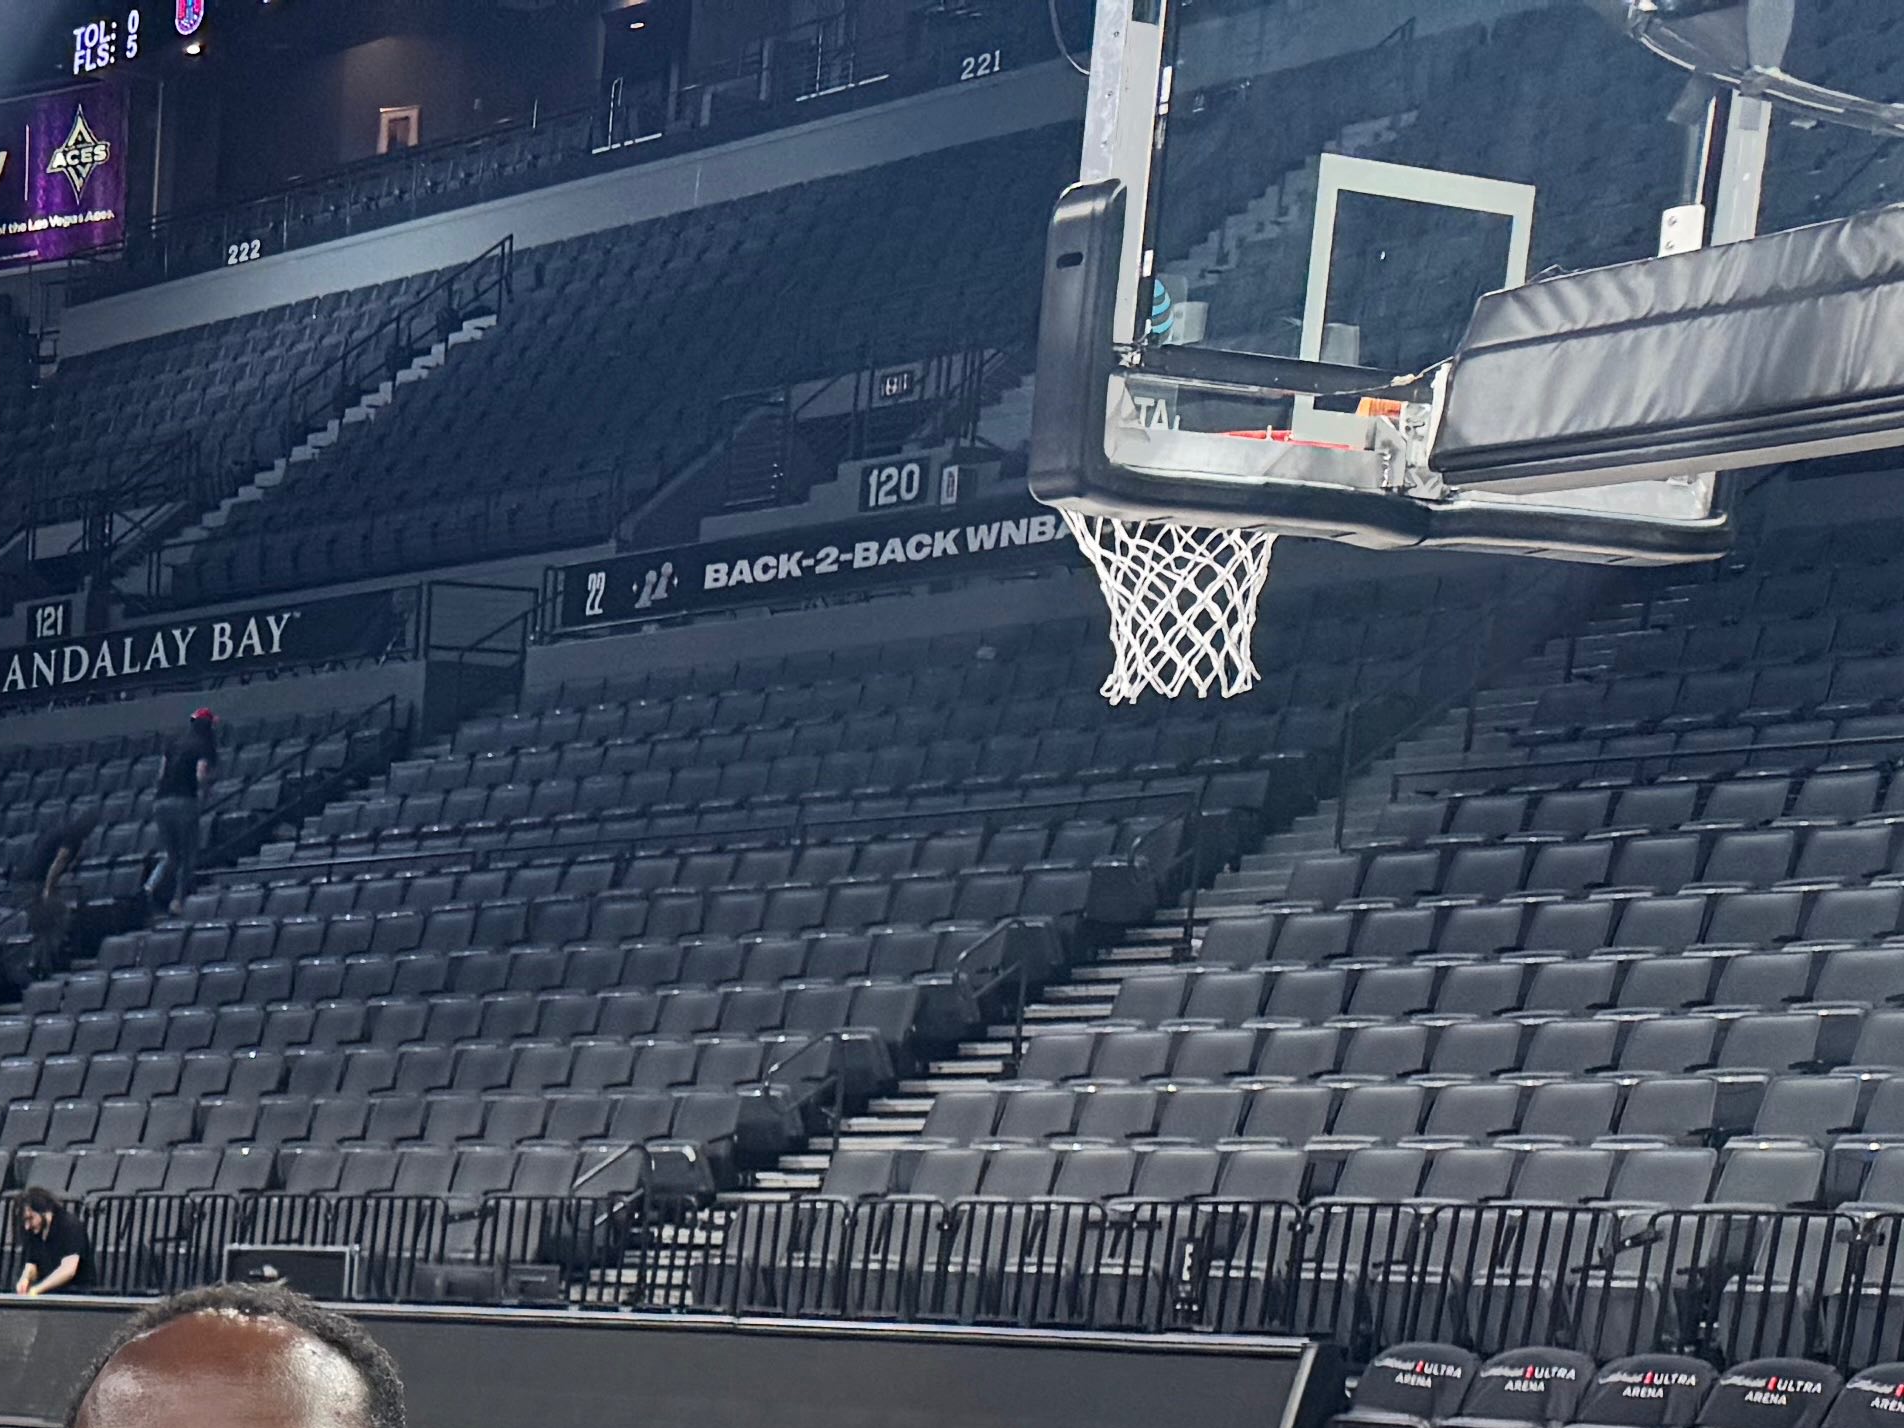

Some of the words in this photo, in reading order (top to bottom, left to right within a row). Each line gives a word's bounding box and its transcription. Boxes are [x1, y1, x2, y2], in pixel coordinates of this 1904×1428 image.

[73, 20, 117, 50] TOL:
[128, 9, 139, 34] 0
[73, 43, 116, 75] FLS:
[126, 34, 138, 59] 5
[960, 53, 1001, 82] 221
[50, 144, 108, 169] ACES
[8, 221, 27, 234] the
[28, 217, 49, 231] Las
[226, 239, 262, 266] 222
[868, 463, 920, 508] 120
[585, 572, 606, 615] 22
[704, 527, 961, 589] BACK-2-BACK
[966, 514, 1074, 552] WNB
[36, 604, 63, 638] 121
[210, 612, 291, 662] BAY
[1395, 1372, 1432, 1388] ARENA
[1424, 1364, 1462, 1379] ULTRA
[1534, 1365, 1576, 1381] ULTRA
[1654, 1373, 1696, 1386] ULTRA
[1504, 1380, 1545, 1392] ARENA
[1623, 1387, 1664, 1398] ARENA
[1777, 1378, 1822, 1394] ULTRA
[1745, 1391, 1787, 1405] ARENA
